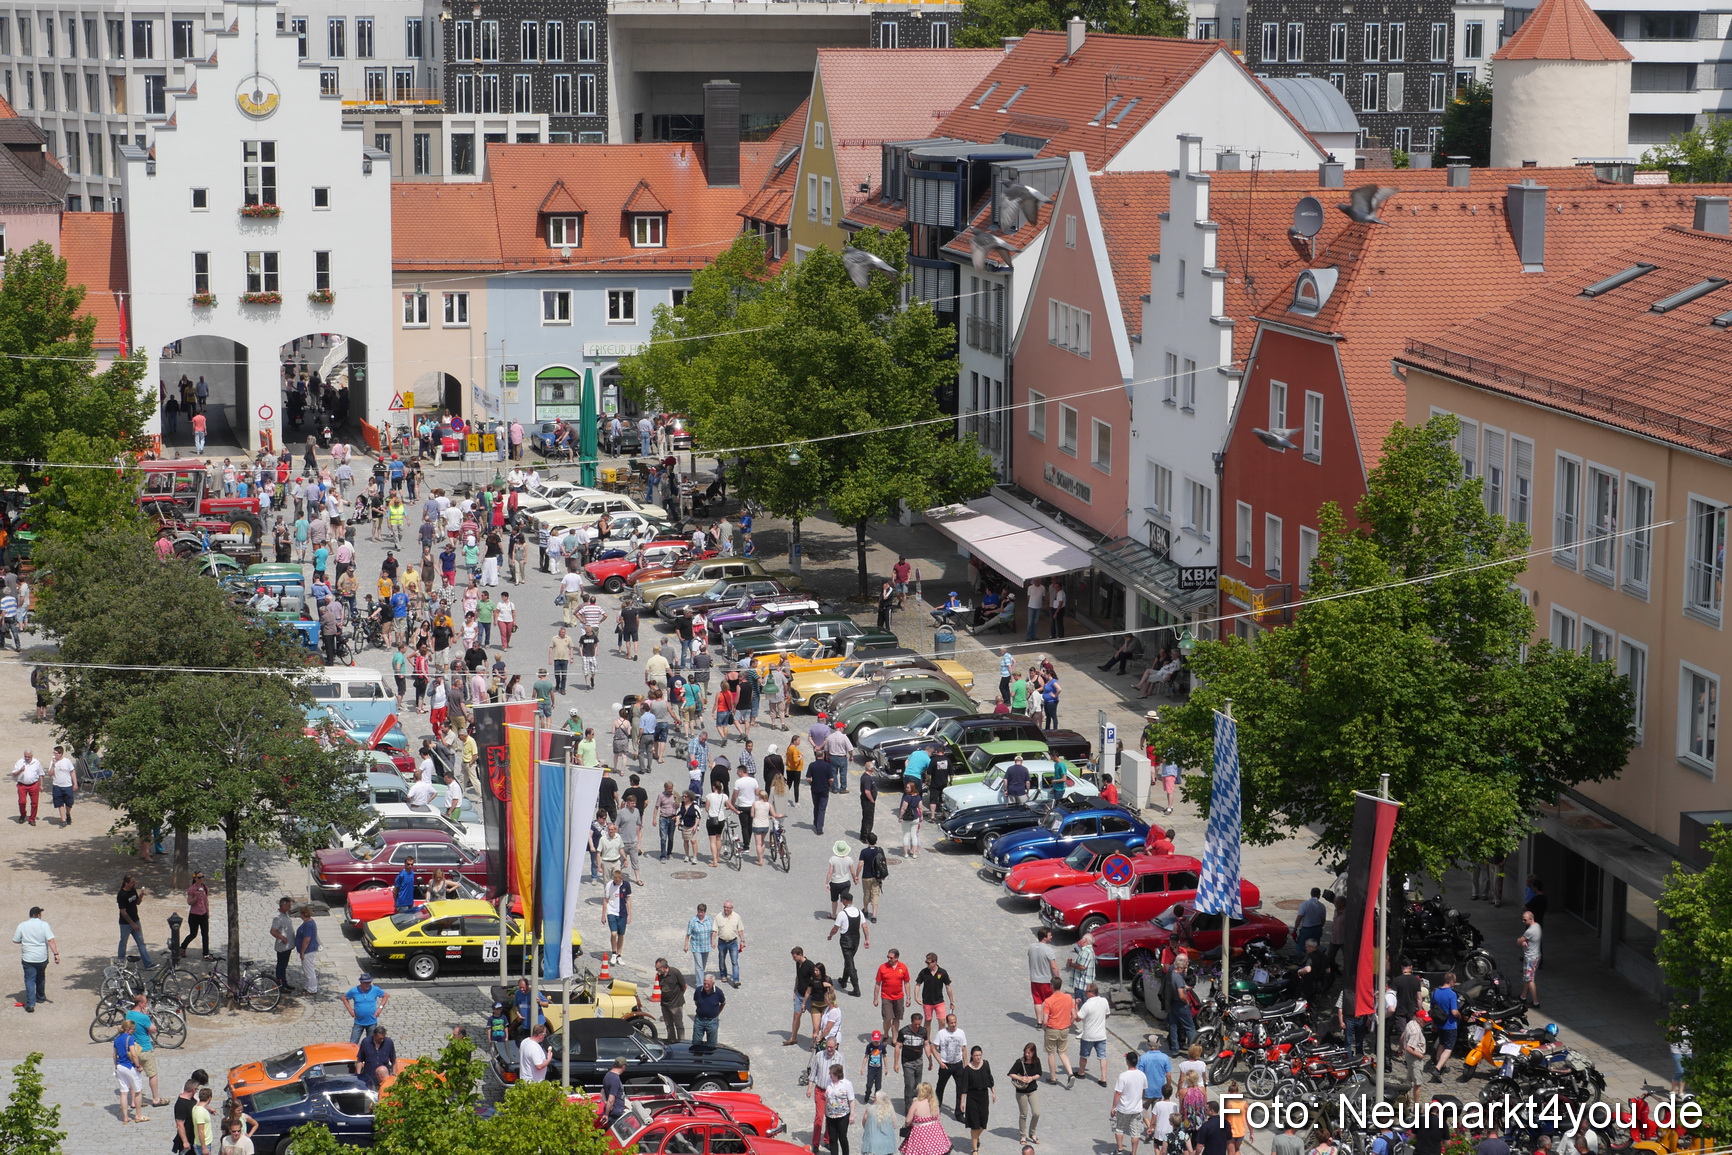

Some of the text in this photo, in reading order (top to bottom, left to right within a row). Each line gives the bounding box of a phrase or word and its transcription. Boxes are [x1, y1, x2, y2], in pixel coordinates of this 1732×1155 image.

[1151, 523, 1167, 548] KBK
[1181, 568, 1216, 580] KBK
[485, 946, 499, 958] 76
